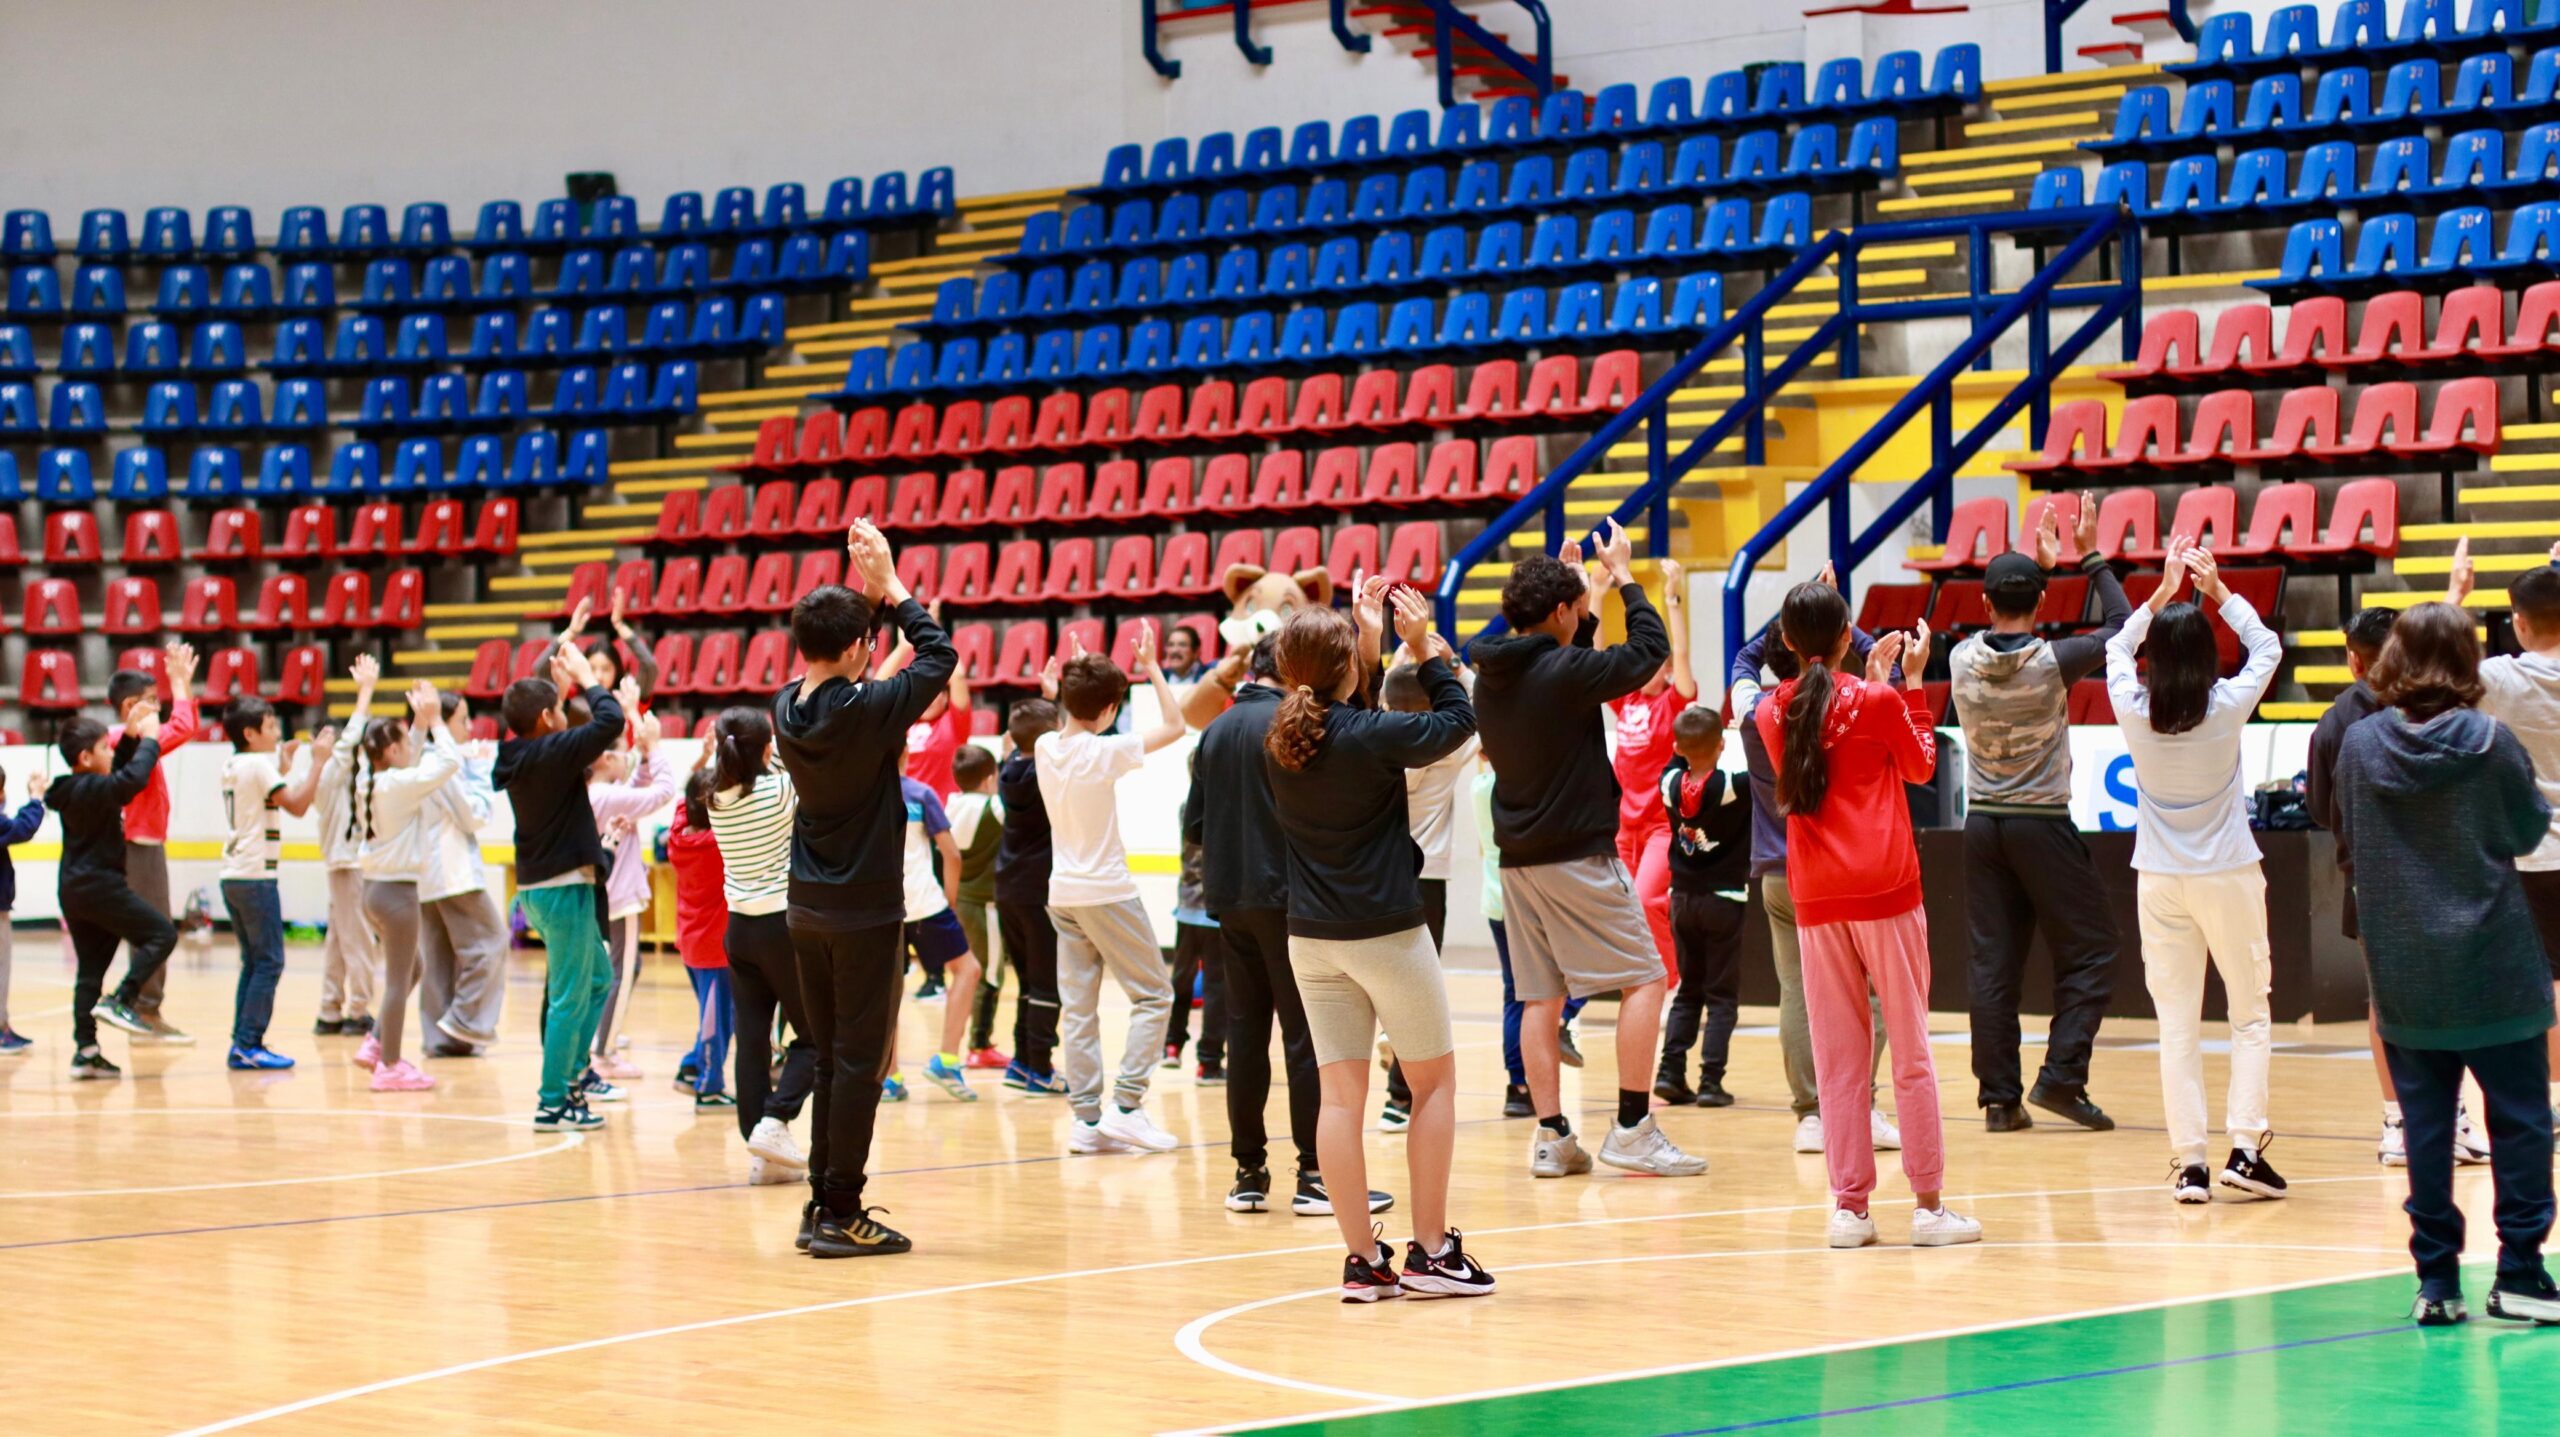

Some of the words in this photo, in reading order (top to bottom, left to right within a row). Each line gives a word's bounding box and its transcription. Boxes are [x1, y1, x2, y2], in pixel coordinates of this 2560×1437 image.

[2481, 59, 2496, 74] 23
[2398, 142, 2413, 156] 23
[2471, 137, 2486, 151] 24
[2459, 215, 2474, 229] 20
[2537, 209, 2551, 223] 21
[2384, 221, 2399, 234] 19
